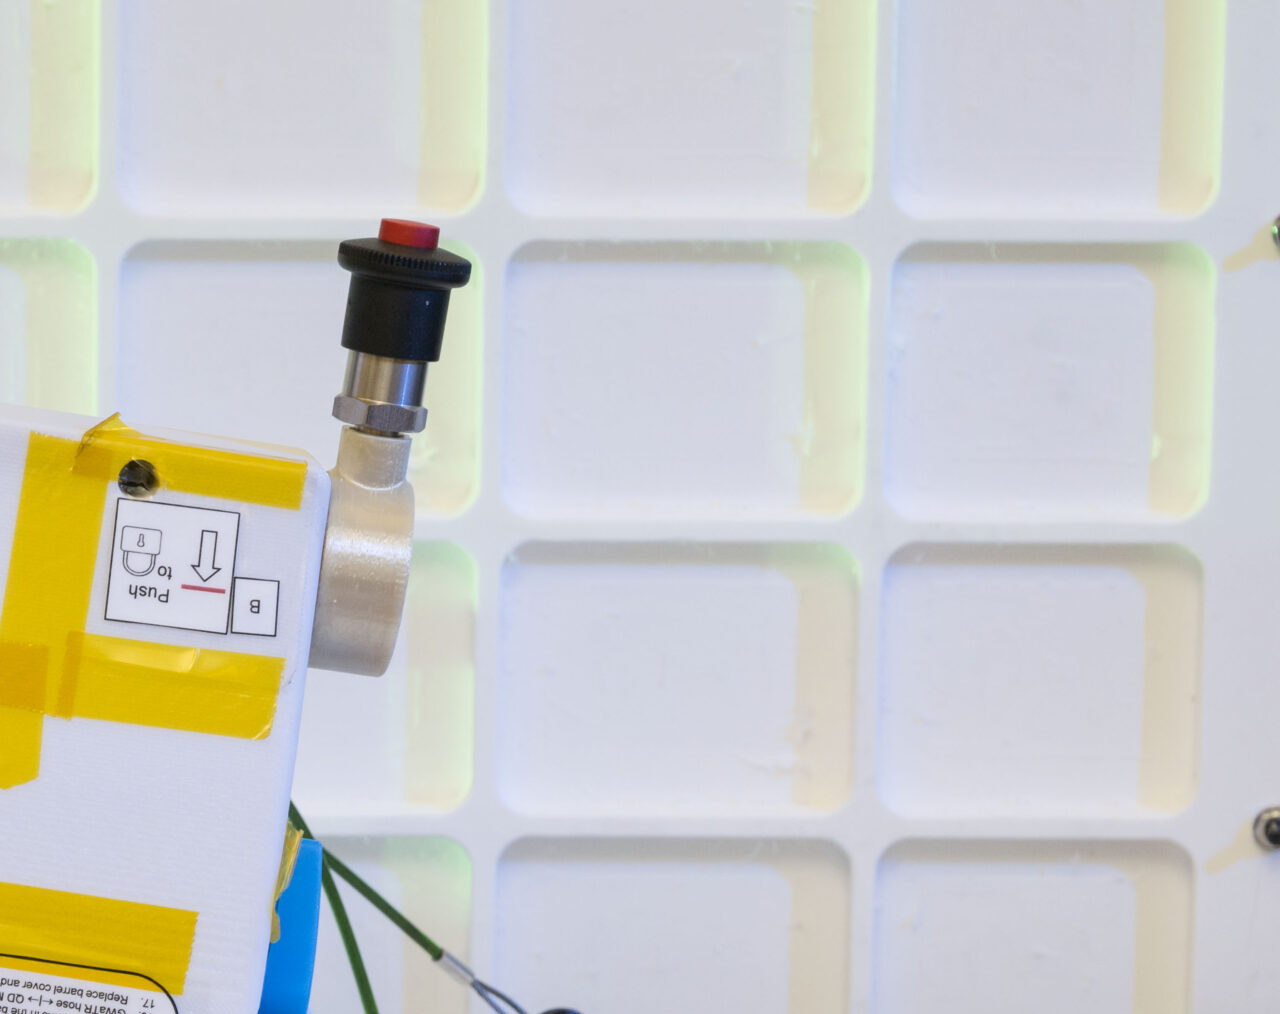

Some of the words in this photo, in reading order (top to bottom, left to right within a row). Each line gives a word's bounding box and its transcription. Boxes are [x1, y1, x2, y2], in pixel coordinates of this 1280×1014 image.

[156, 564, 173, 581] to
[128, 583, 170, 604] Push
[249, 598, 261, 615] B
[20, 979, 52, 992] cover
[52, 984, 84, 999] barrel
[84, 988, 129, 1006] Replace
